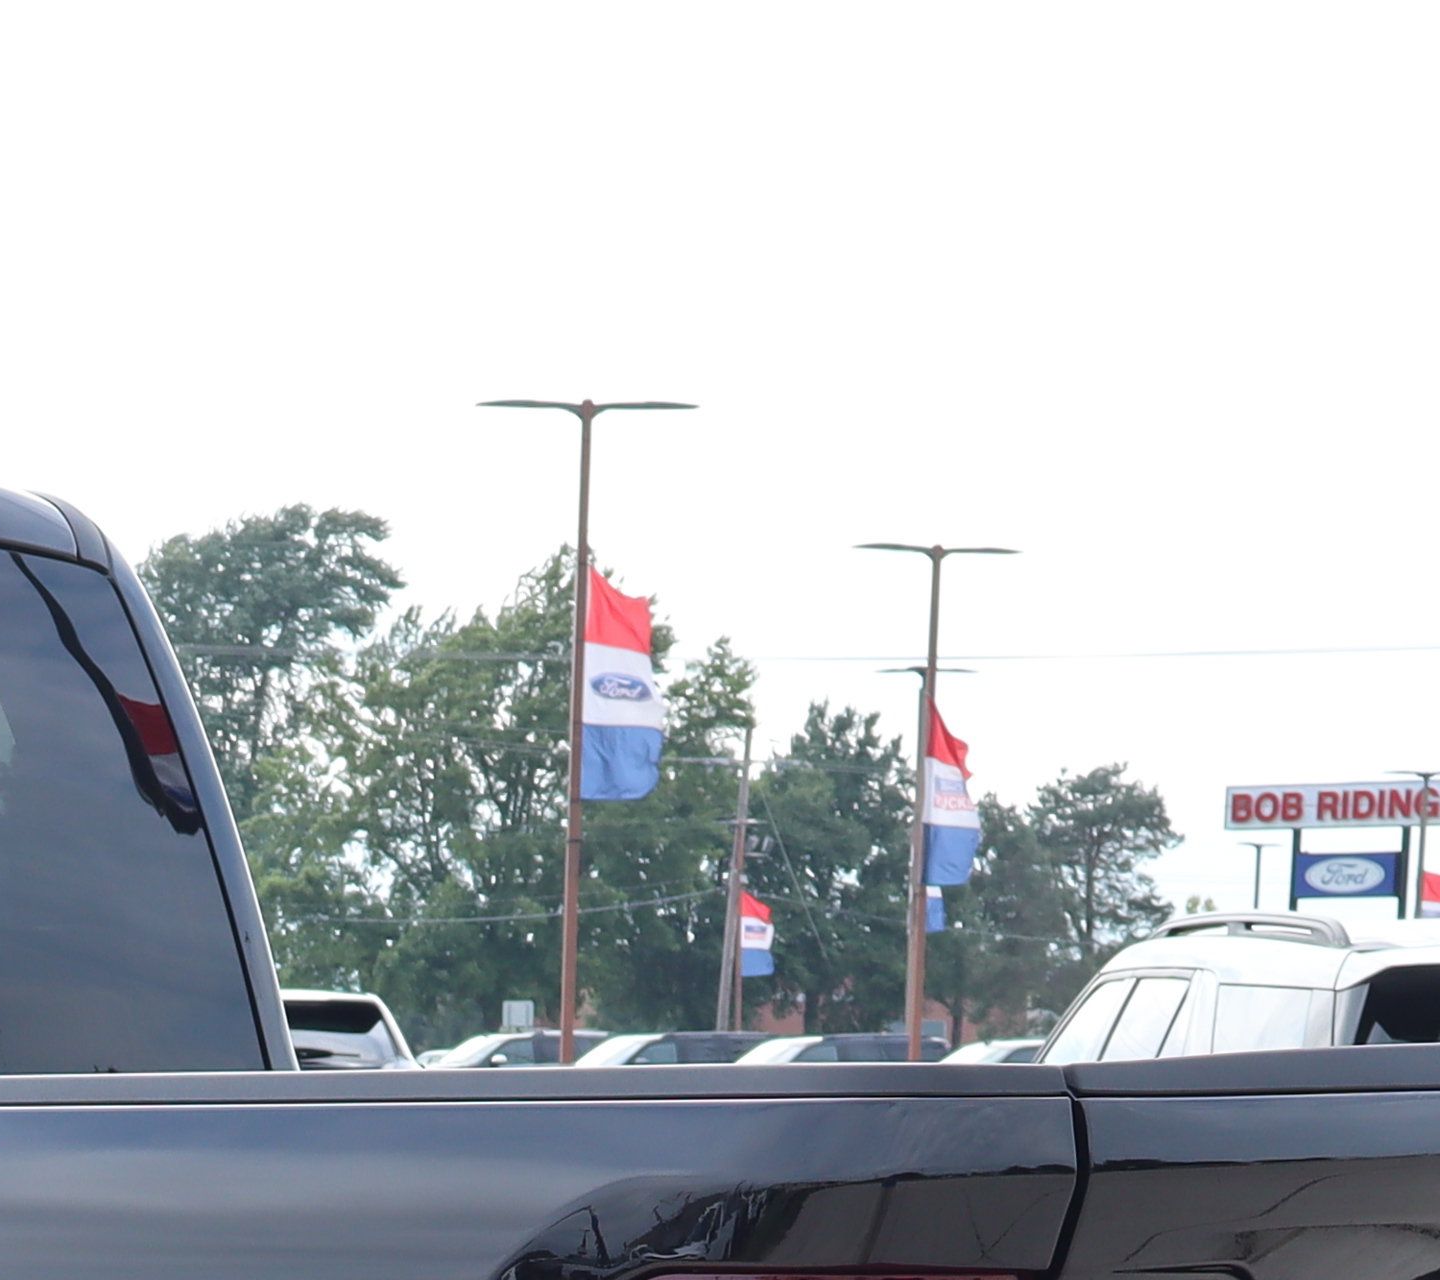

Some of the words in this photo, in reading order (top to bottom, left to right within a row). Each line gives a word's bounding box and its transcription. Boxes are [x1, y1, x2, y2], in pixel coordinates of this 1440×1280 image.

[600, 675, 643, 697] Ford
[1230, 792, 1304, 824] BOB
[1320, 862, 1367, 887] Ford
